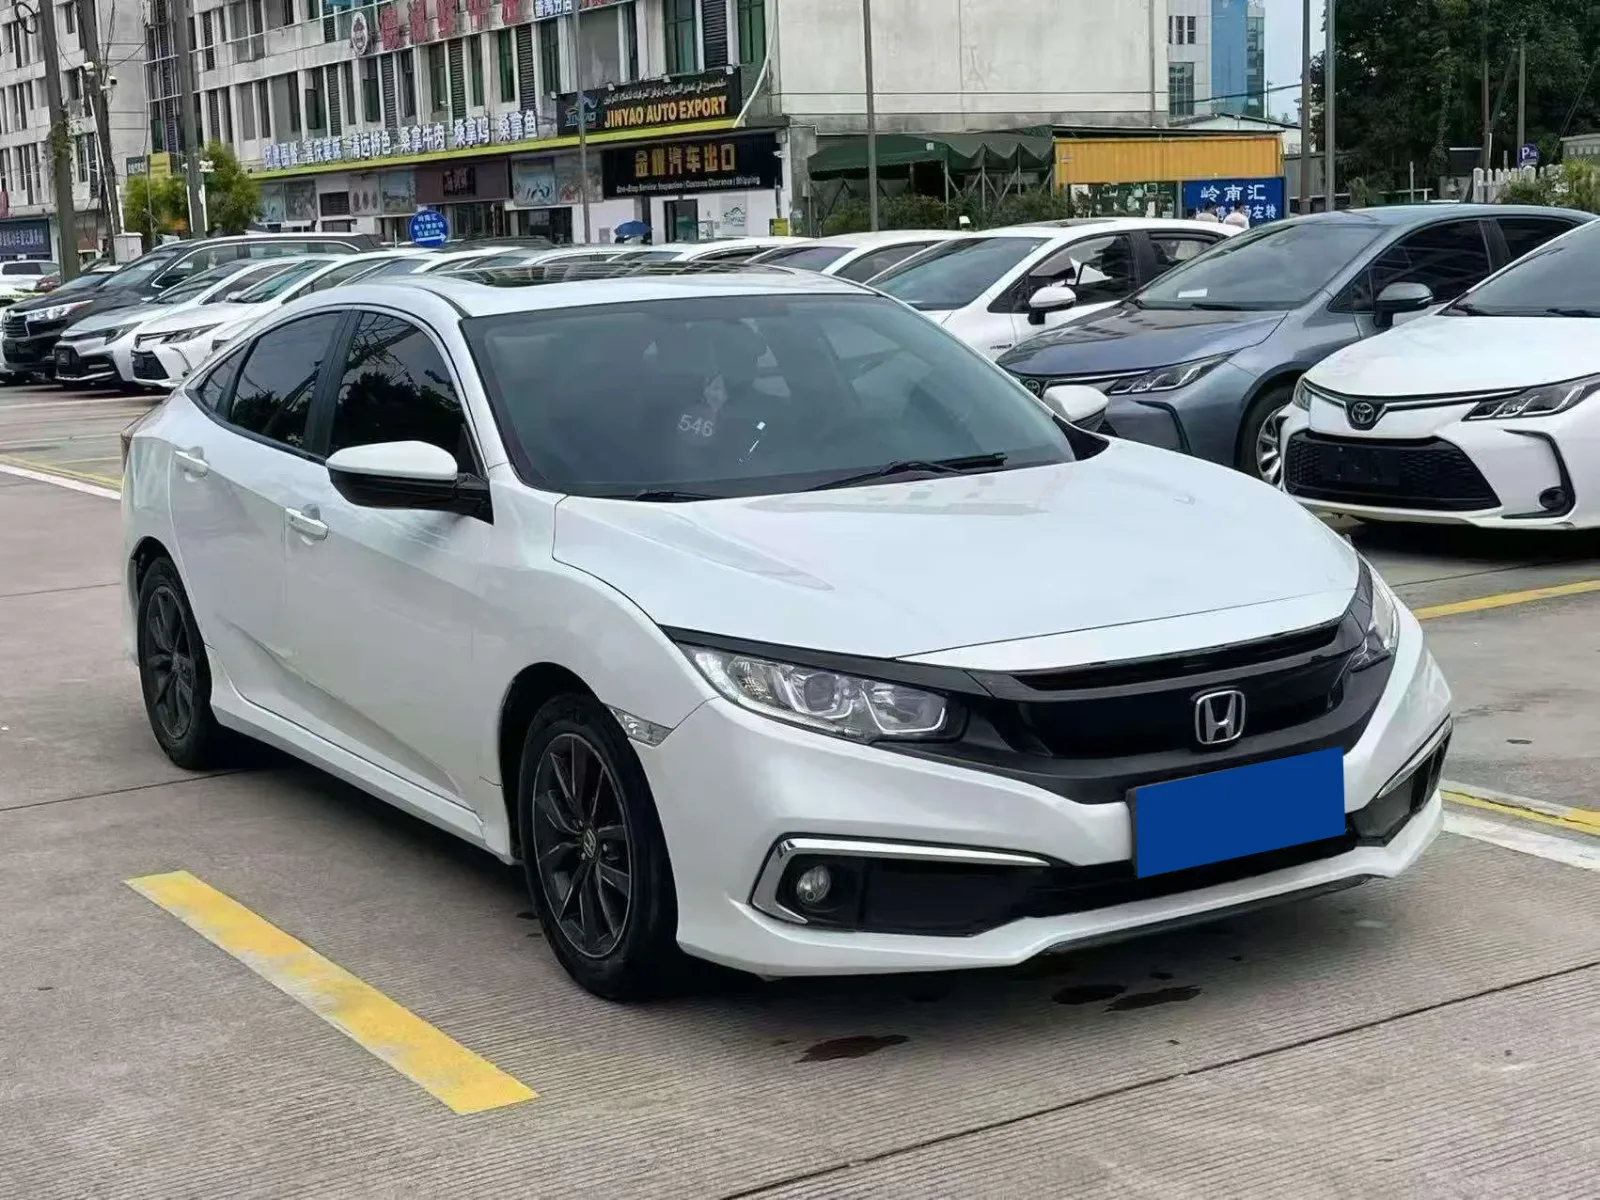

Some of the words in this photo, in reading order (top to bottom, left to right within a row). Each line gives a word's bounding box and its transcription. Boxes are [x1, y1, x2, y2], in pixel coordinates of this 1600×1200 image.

[604, 106, 644, 128] JINYAO
[645, 101, 677, 123] AUTO
[679, 95, 727, 120] EXPORT
[400, 122, 446, 153] 桑拿牛肉
[499, 109, 537, 141] 桑拿鱼
[735, 175, 761, 186] Shipping
[1200, 184, 1266, 202] 岭南汇
[678, 413, 714, 437] 546
